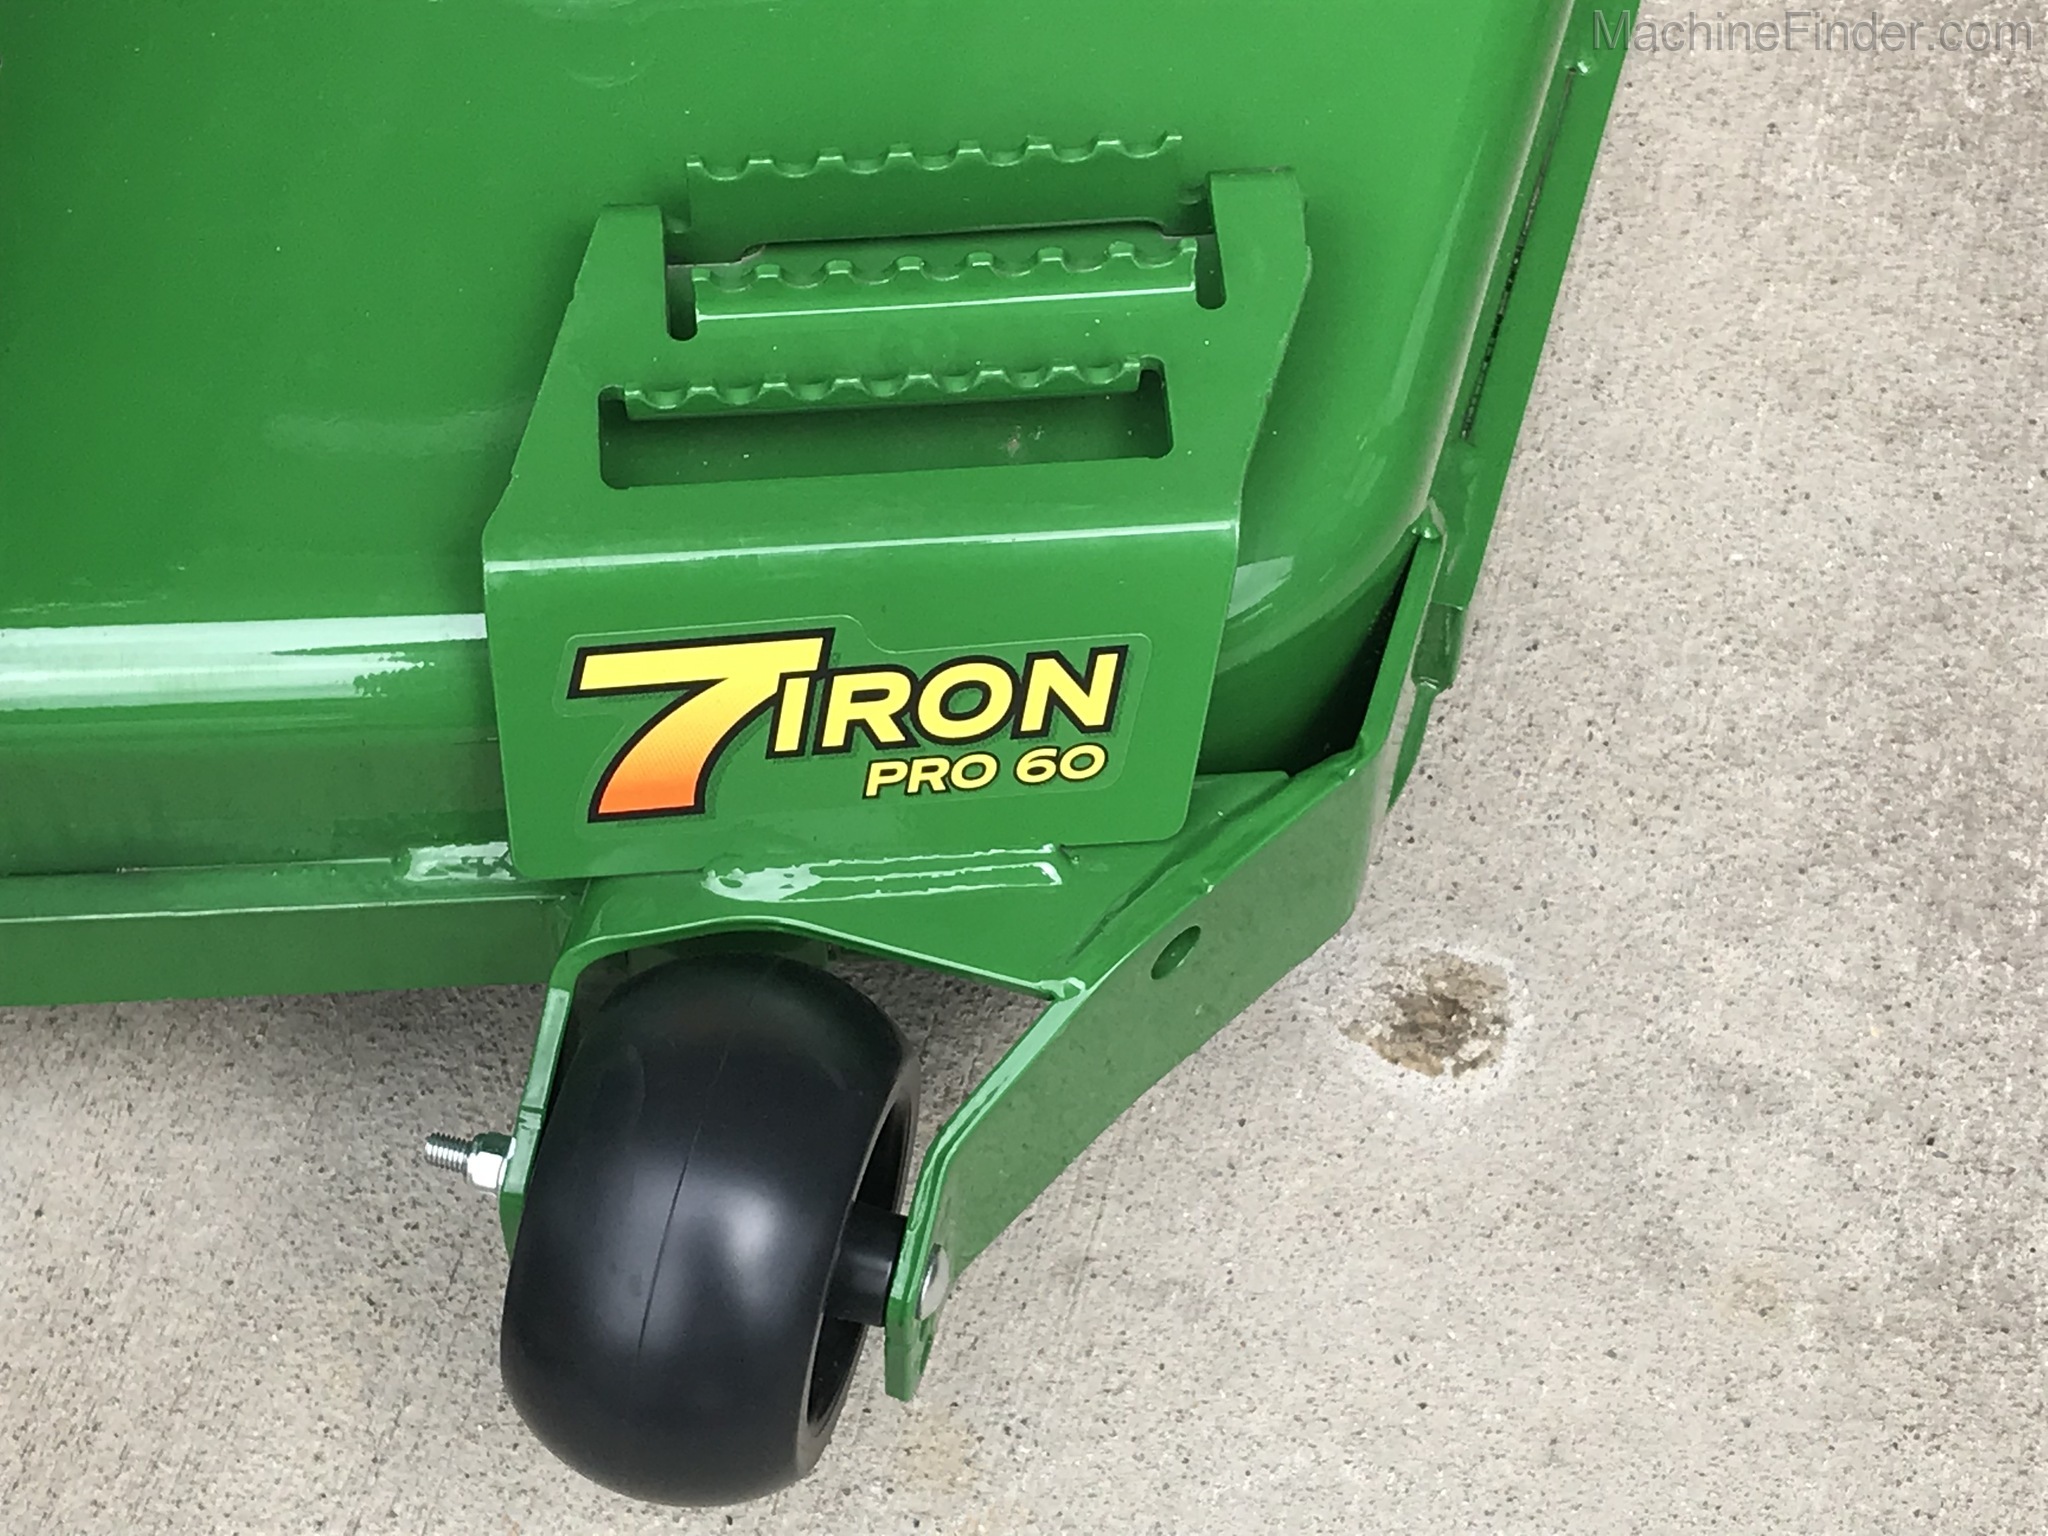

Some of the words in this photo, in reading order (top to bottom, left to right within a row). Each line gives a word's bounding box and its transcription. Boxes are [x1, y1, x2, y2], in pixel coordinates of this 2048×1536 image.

[766, 645, 1128, 759] IRON
[863, 752, 1000, 799] PRO
[1014, 743, 1108, 785] 60
